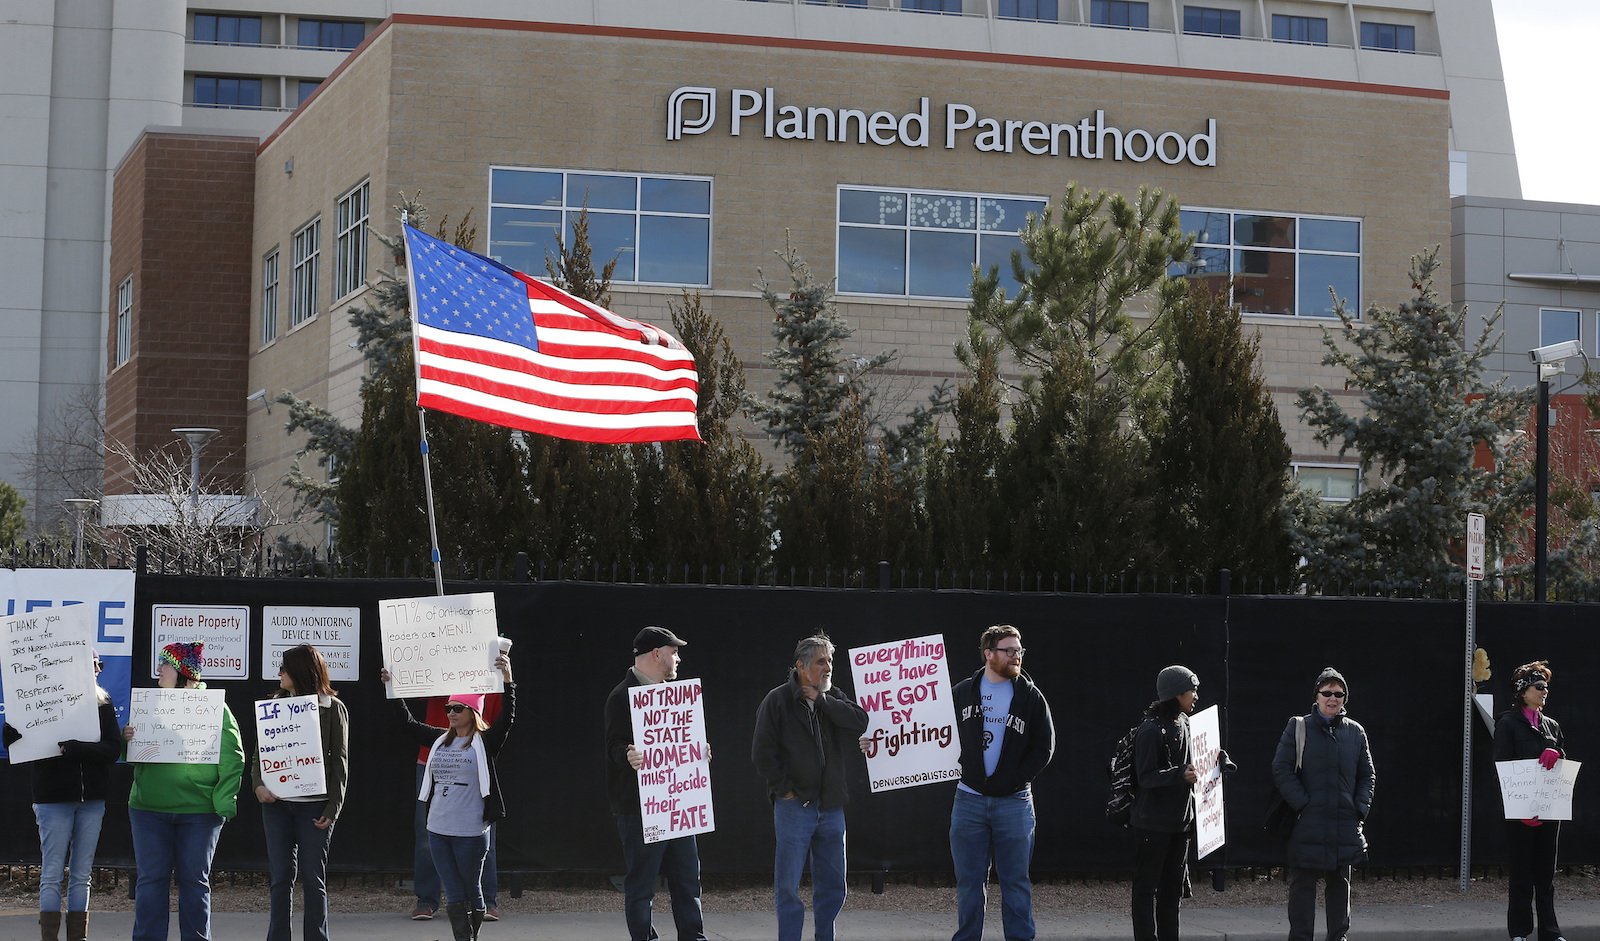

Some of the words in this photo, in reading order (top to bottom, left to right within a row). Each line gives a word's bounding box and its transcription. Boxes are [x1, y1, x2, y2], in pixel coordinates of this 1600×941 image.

[730, 87, 930, 148] Planned
[945, 103, 1217, 167] Parenthood
[879, 195, 1005, 230] PROUD
[1473, 518, 1479, 531] NO
[1469, 532, 1484, 544] PARKING
[271, 616, 298, 627] AUDIO
[300, 616, 353, 627] MONITORING
[387, 601, 421, 624] 77%
[426, 605, 437, 620] of
[7, 618, 39, 633] THANK
[160, 614, 193, 627] Private
[198, 614, 241, 630] Property
[39, 632, 53, 640] THE
[167, 634, 197, 642] Planned
[282, 629, 310, 640] DEVICE
[313, 630, 321, 640] IN
[324, 630, 341, 641] USE.
[387, 630, 419, 642] leaders
[422, 631, 436, 639] are
[438, 621, 472, 637] MEN!!
[389, 644, 424, 663] 100%
[429, 644, 440, 657] of
[443, 644, 468, 654] those
[471, 642, 487, 651] will
[854, 640, 944, 667] everything
[391, 668, 434, 687] NEVER
[441, 667, 456, 682] be
[864, 669, 892, 684] we
[899, 662, 938, 680] have
[16, 684, 64, 700] RESPECTING
[133, 690, 150, 702] If
[155, 691, 176, 701] the
[180, 691, 209, 703] fetus
[633, 688, 655, 709] NOT
[656, 683, 702, 706] TRUMP
[860, 690, 895, 713] WE
[896, 680, 938, 706] GOT
[25, 703, 32, 712] A
[132, 708, 148, 718] you
[154, 707, 176, 715] save
[183, 706, 191, 714] is
[258, 702, 281, 720] If
[891, 707, 914, 725] BY
[643, 708, 669, 727] NOT
[671, 709, 693, 726] THE
[983, 715, 1005, 723] lture!
[151, 723, 165, 735] you
[171, 723, 206, 731] continue
[207, 723, 219, 731] to
[264, 723, 301, 739] against
[643, 726, 691, 745] STATE
[130, 738, 158, 747] Protect
[866, 721, 952, 759] fighting
[1192, 731, 1208, 757] FREE
[262, 755, 293, 771] Don't
[295, 755, 322, 766] have
[641, 741, 702, 770] WOMEN
[279, 773, 300, 783] one
[641, 765, 674, 787] must
[668, 767, 707, 795] decide
[1502, 776, 1537, 790] Planned
[1507, 790, 1529, 800] Keep
[644, 795, 680, 815] their
[670, 804, 708, 832] FATE
